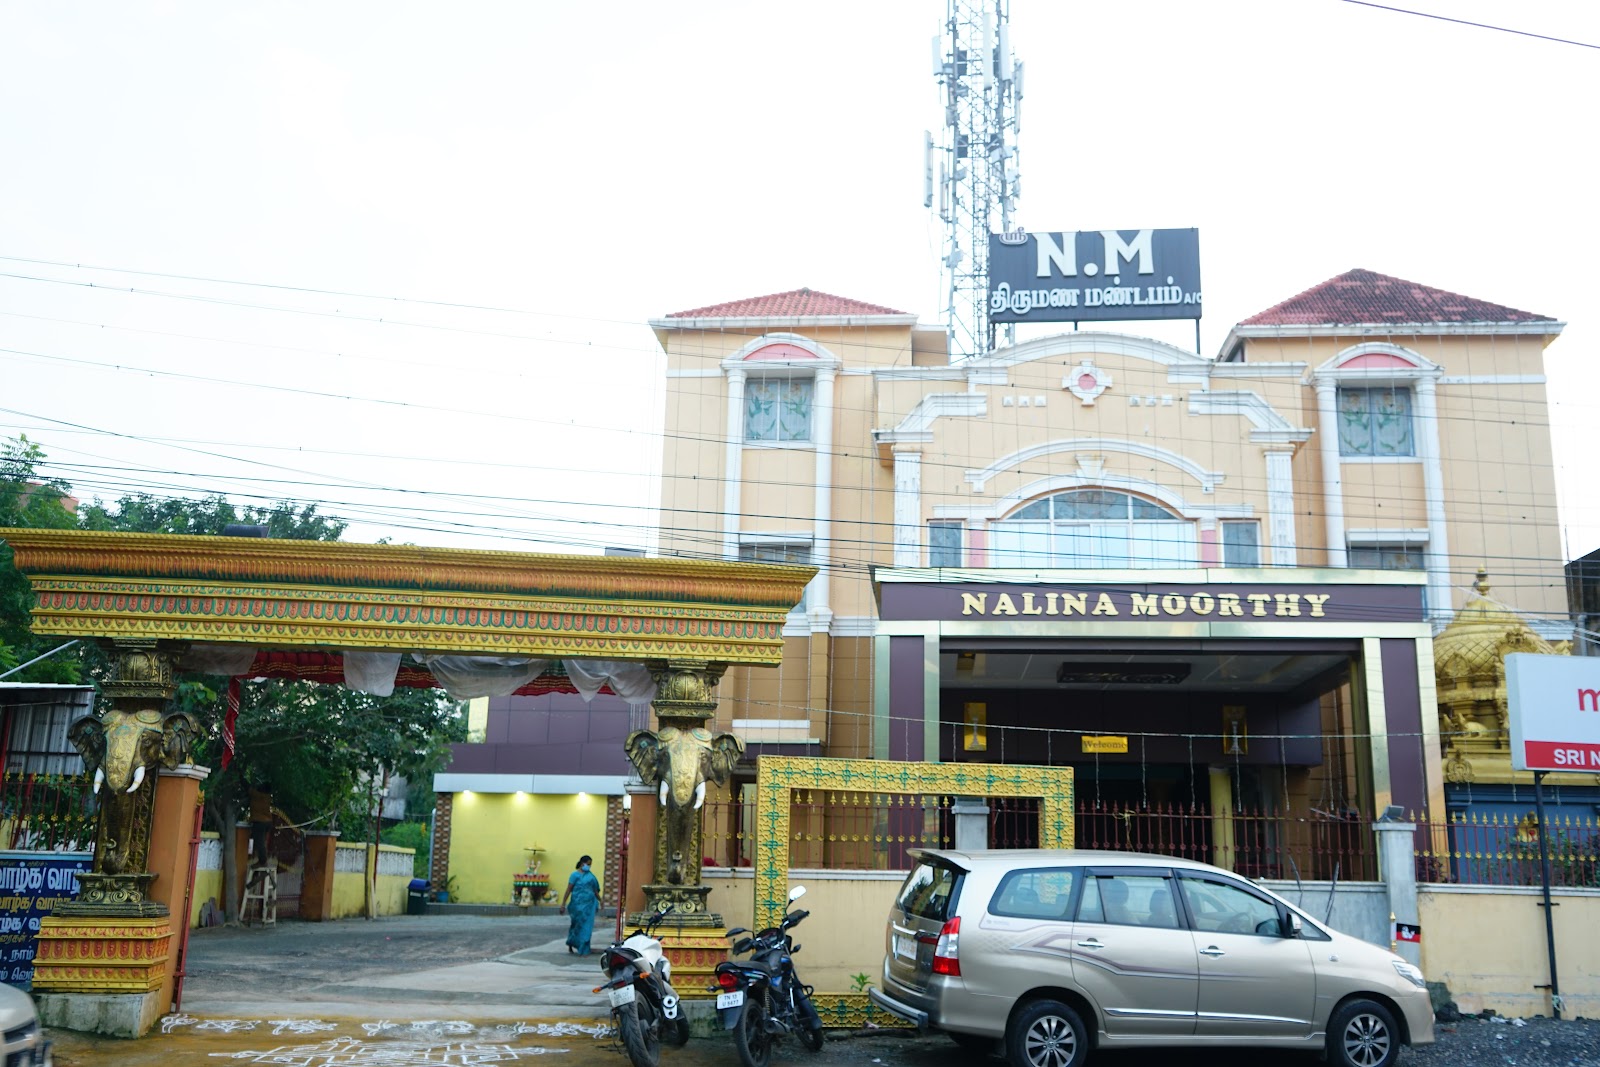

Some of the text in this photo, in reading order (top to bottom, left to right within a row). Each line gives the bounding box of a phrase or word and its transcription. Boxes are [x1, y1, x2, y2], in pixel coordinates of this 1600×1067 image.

[1032, 229, 1154, 277] N.M
[990, 282, 1080, 315] திருமண
[1084, 276, 1183, 307] மண்டபம்
[961, 591, 1331, 617] NALINA MOORTHY
[1083, 740, 1127, 749] Welcome
[1554, 748, 1585, 766] SRI
